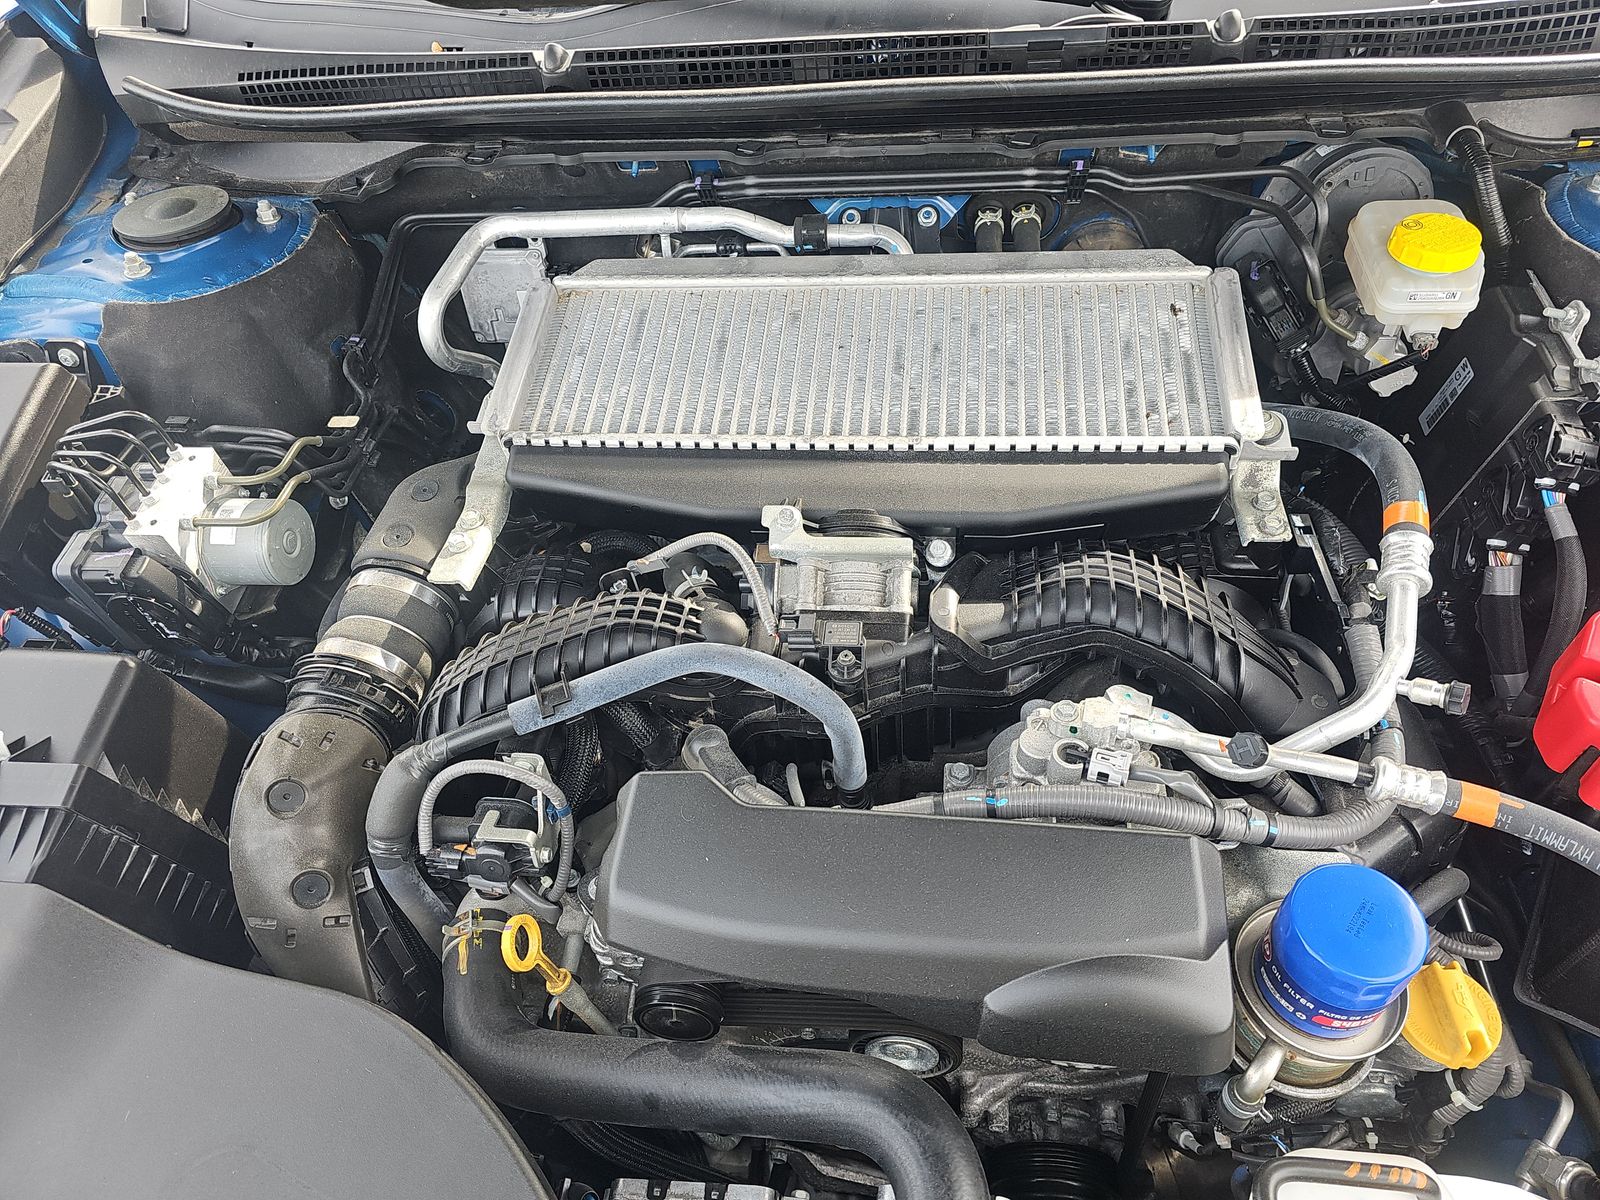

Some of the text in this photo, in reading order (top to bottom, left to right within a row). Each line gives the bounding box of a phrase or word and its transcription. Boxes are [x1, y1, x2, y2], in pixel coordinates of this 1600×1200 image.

[1525, 823, 1595, 864] HYLAMMIT
[1271, 965, 1282, 982] OIL
[1283, 982, 1315, 1009] FILTER
[1318, 1009, 1347, 1020] FILTRO
